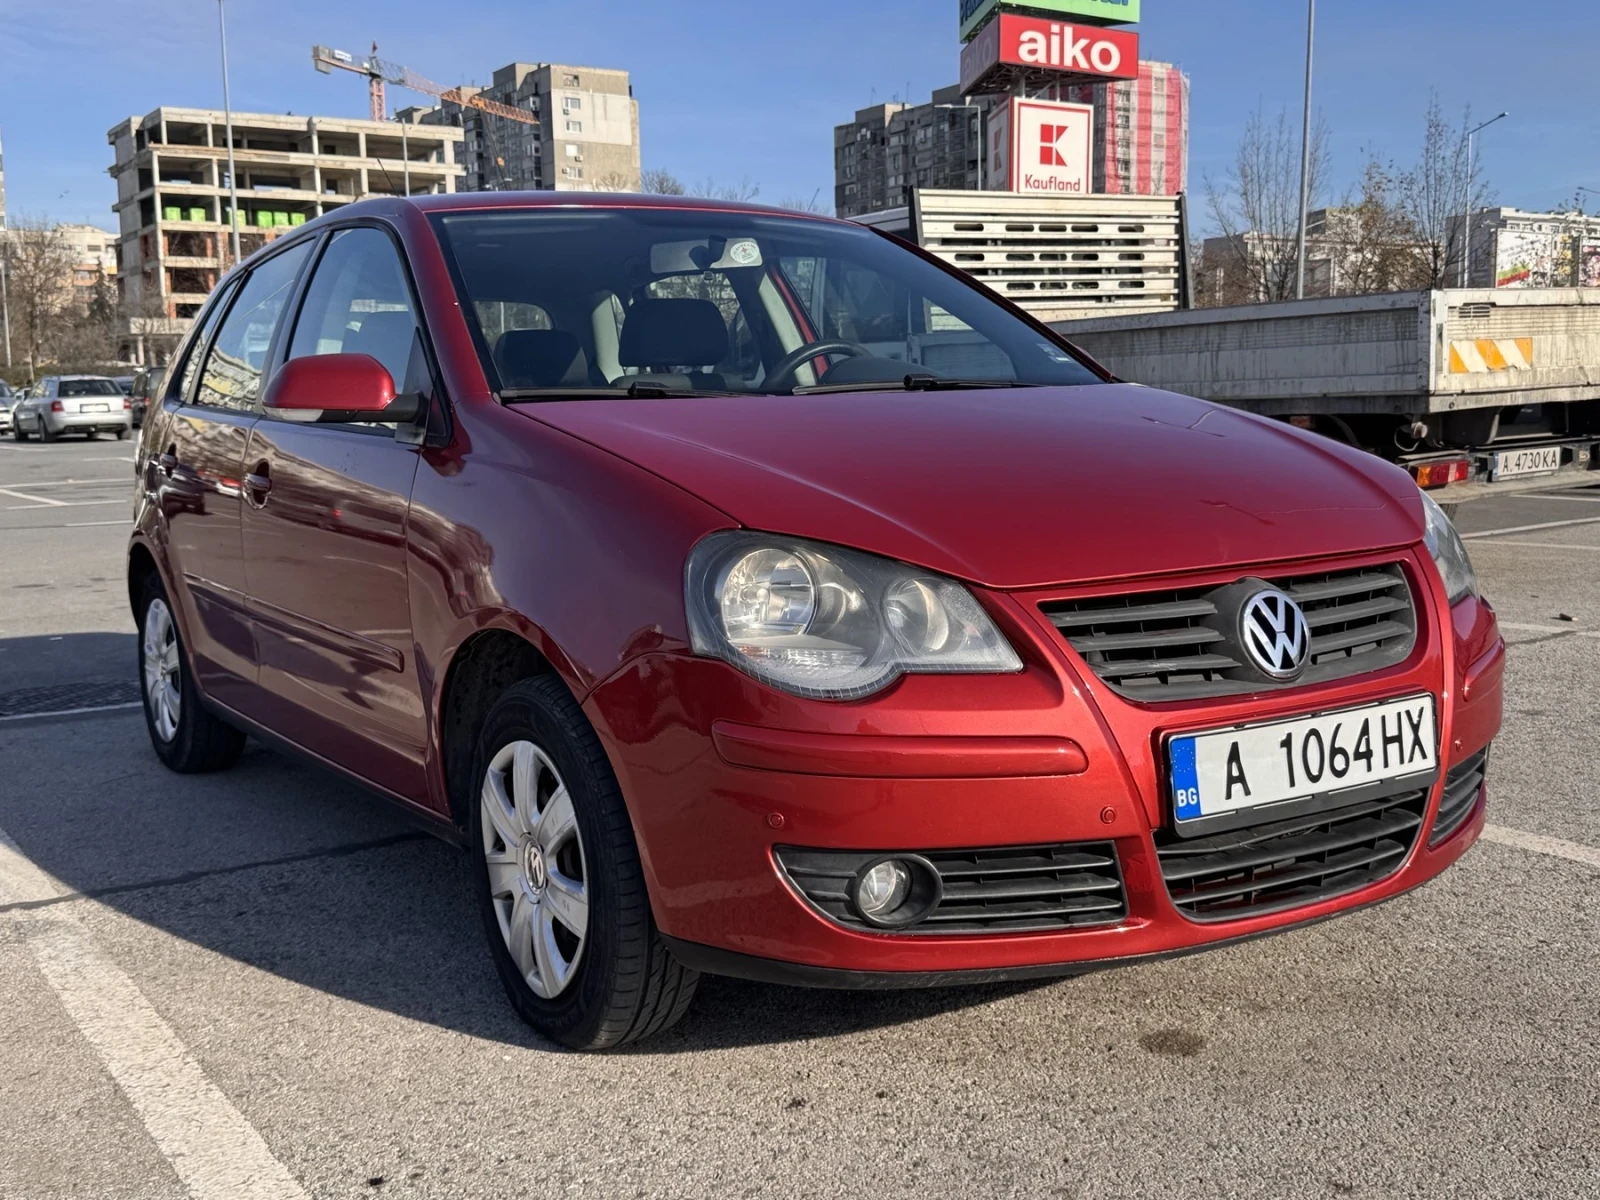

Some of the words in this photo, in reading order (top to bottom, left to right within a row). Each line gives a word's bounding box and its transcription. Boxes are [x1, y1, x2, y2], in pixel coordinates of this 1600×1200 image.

[1018, 24, 1120, 73] aiko
[1024, 174, 1081, 192] Kaufland
[1225, 741, 1251, 800] A
[1177, 788, 1198, 807] BG
